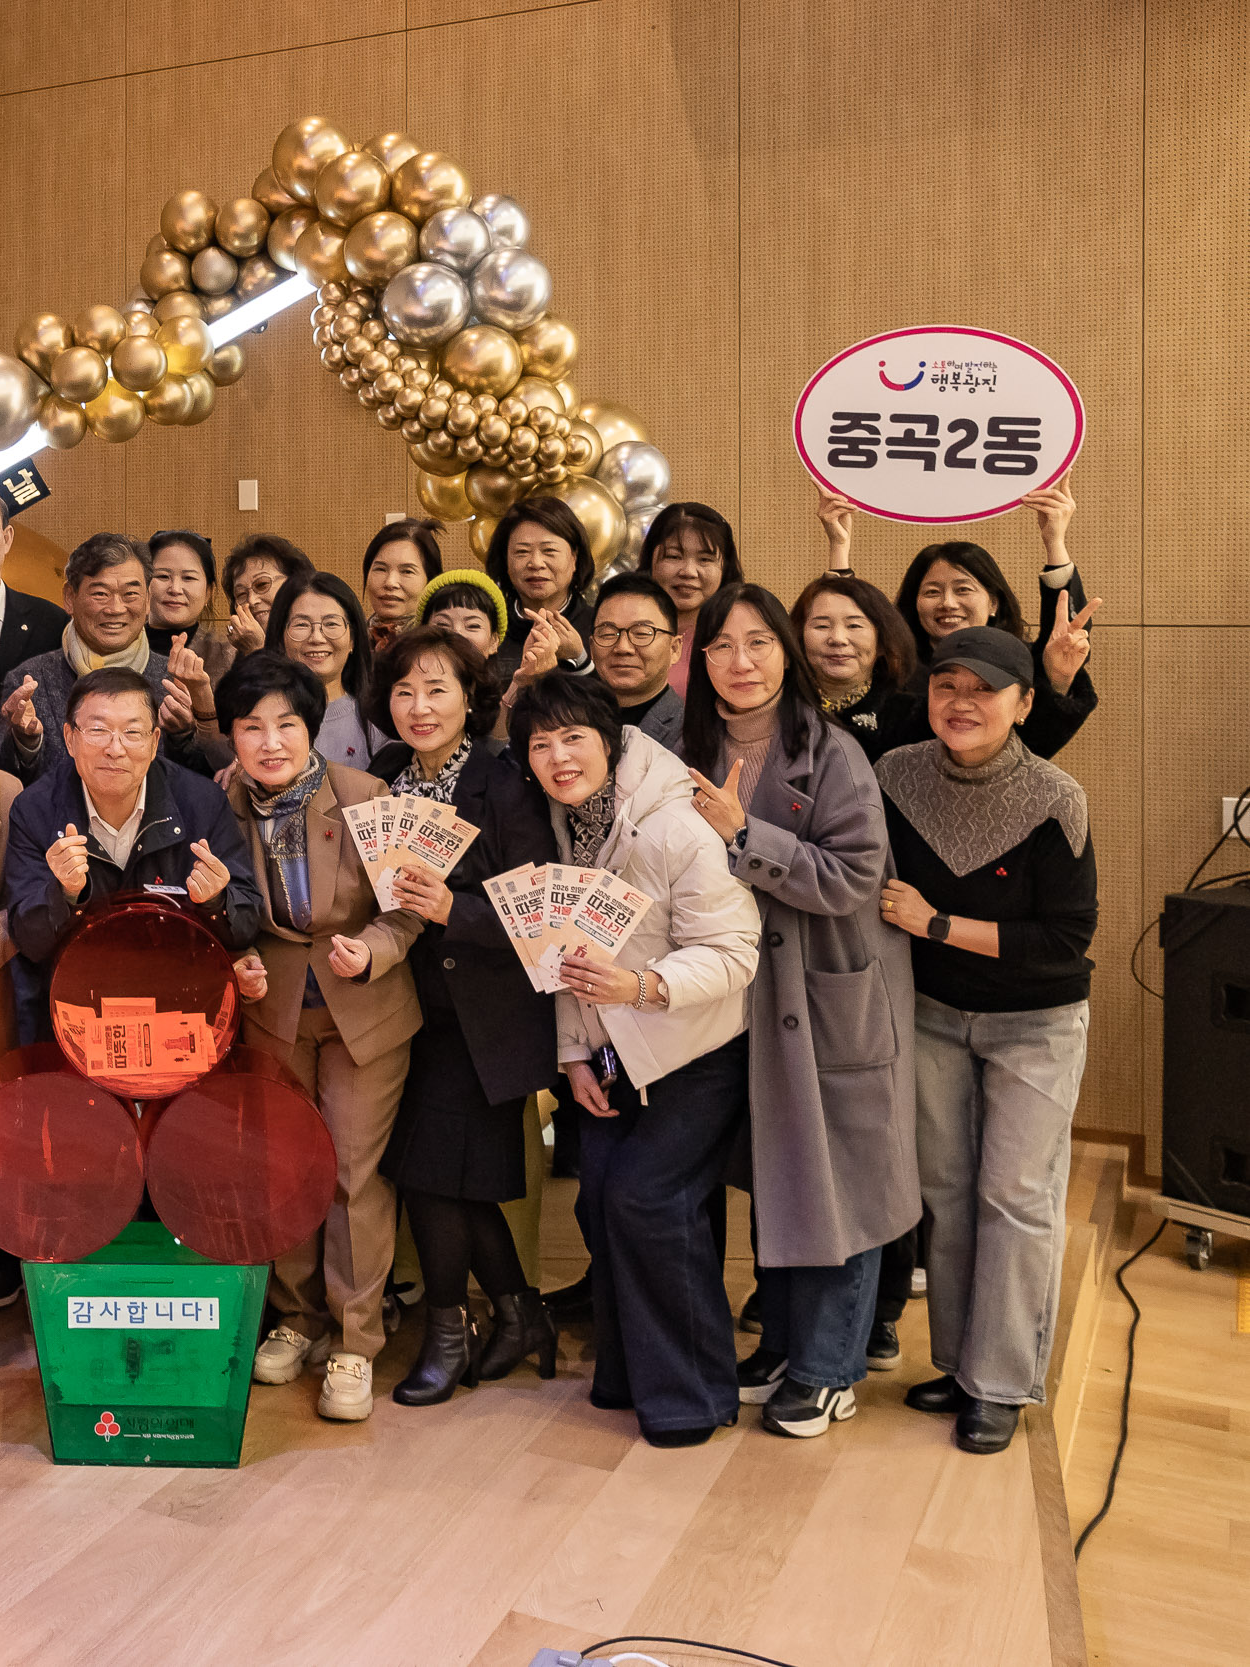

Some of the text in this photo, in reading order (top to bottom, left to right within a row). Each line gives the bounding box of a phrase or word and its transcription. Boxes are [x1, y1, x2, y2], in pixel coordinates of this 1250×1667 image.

[930, 371, 997, 393] 행복광진
[827, 411, 1042, 476] 중곡2동
[2, 468, 41, 506] 날
[414, 834, 453, 859] 겨울나기
[419, 824, 459, 852] 따뜻한
[512, 894, 528, 903] 2026
[515, 896, 544, 915] 따뜻
[595, 888, 611, 901] 2026
[581, 906, 624, 936] 겨울나기
[587, 894, 631, 928] 따뜻한
[113, 1024, 127, 1068] 따뜻한
[72, 1301, 214, 1324] 감사합니다!
